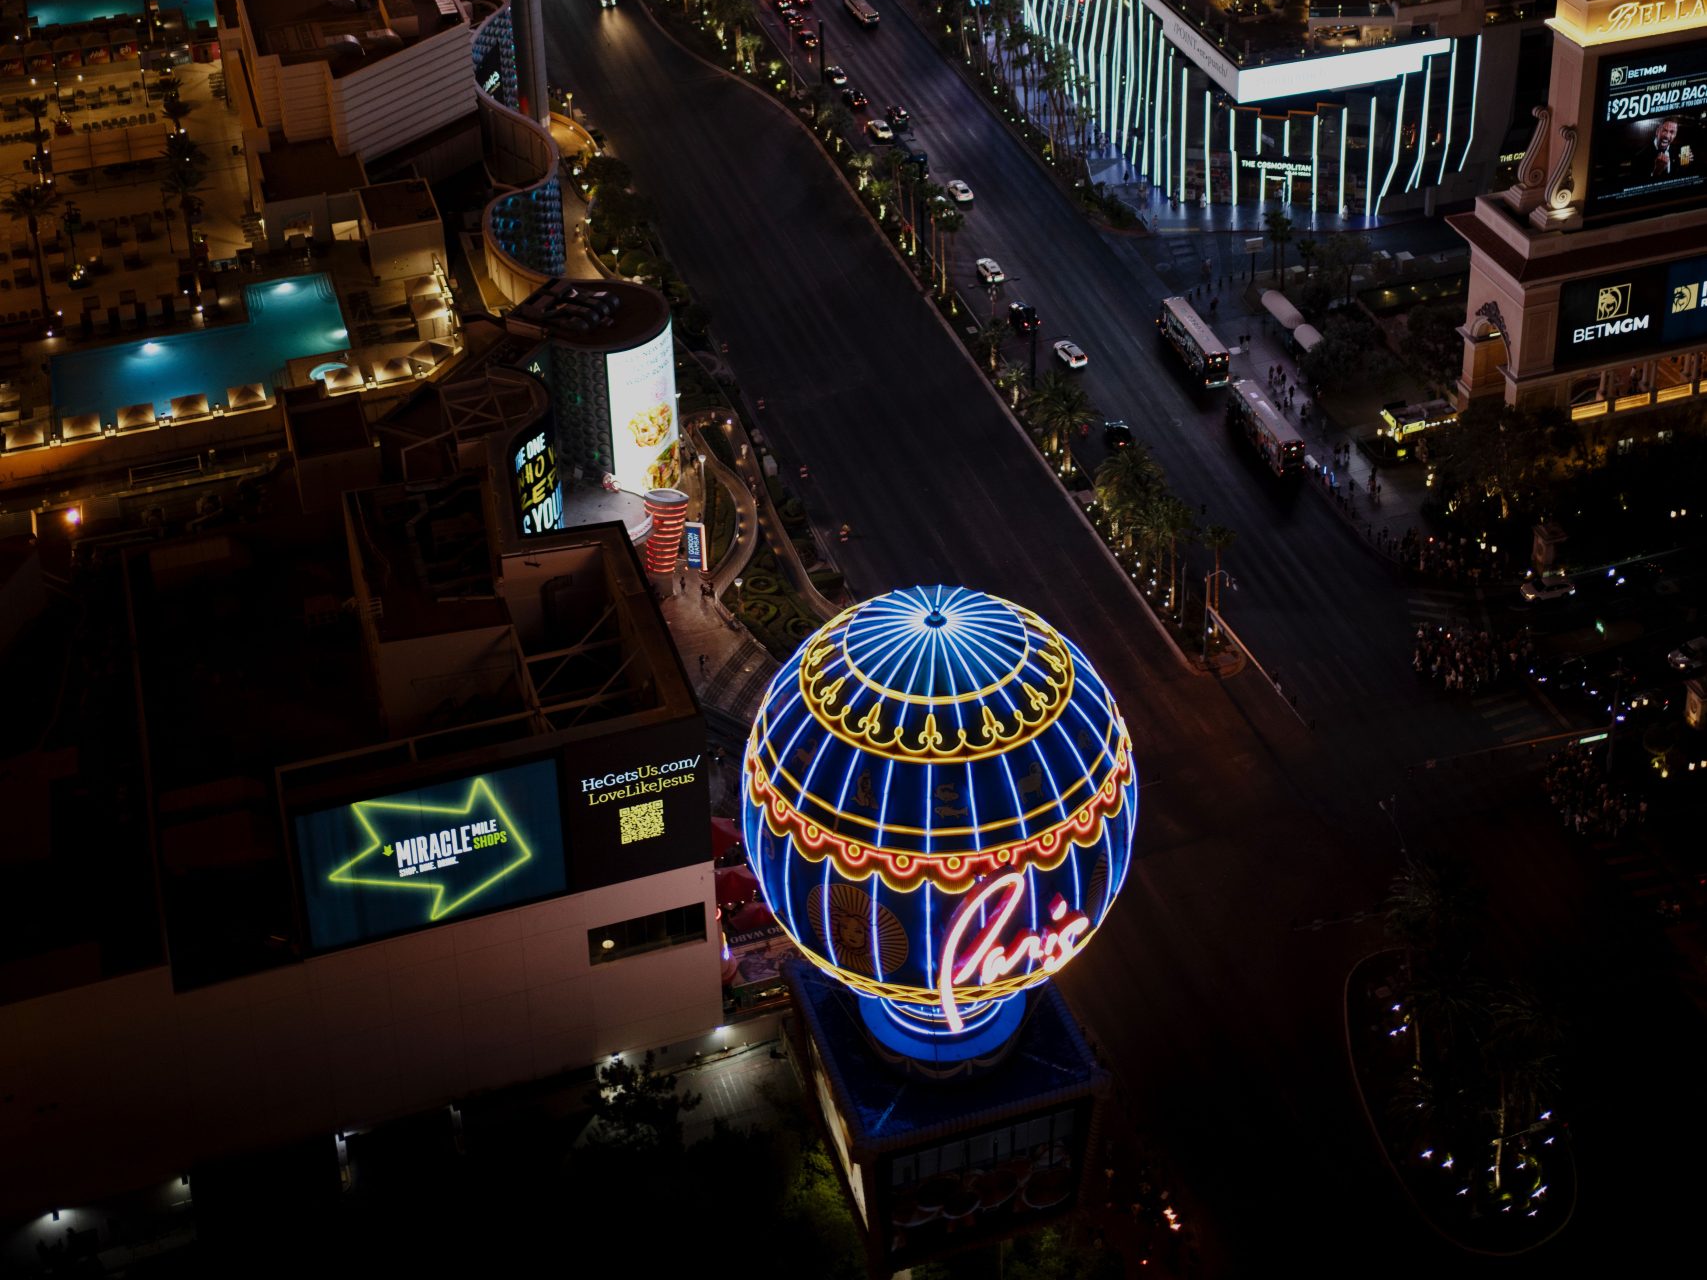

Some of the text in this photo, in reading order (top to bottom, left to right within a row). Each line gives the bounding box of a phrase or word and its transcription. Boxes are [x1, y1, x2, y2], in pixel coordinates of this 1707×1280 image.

[1627, 64, 1667, 79] BETMGM
[1646, 79, 1687, 92] FIRST BET OFFER
[1611, 93, 1651, 120] $250
[1651, 89, 1680, 107] PAID
[1681, 84, 1707, 101] BAC
[1241, 159, 1312, 172] THE COSMOPOLITAN
[1500, 153, 1513, 162] THE
[1573, 314, 1650, 343] BETMGM
[526, 431, 546, 460] ONE
[581, 755, 700, 793] HeGetsUs.com/
[588, 773, 695, 806] LoveLikeJesus
[395, 819, 498, 869] MIRACLE MILE
[473, 830, 508, 850] SHOPS
[939, 871, 1090, 1032] Paris
